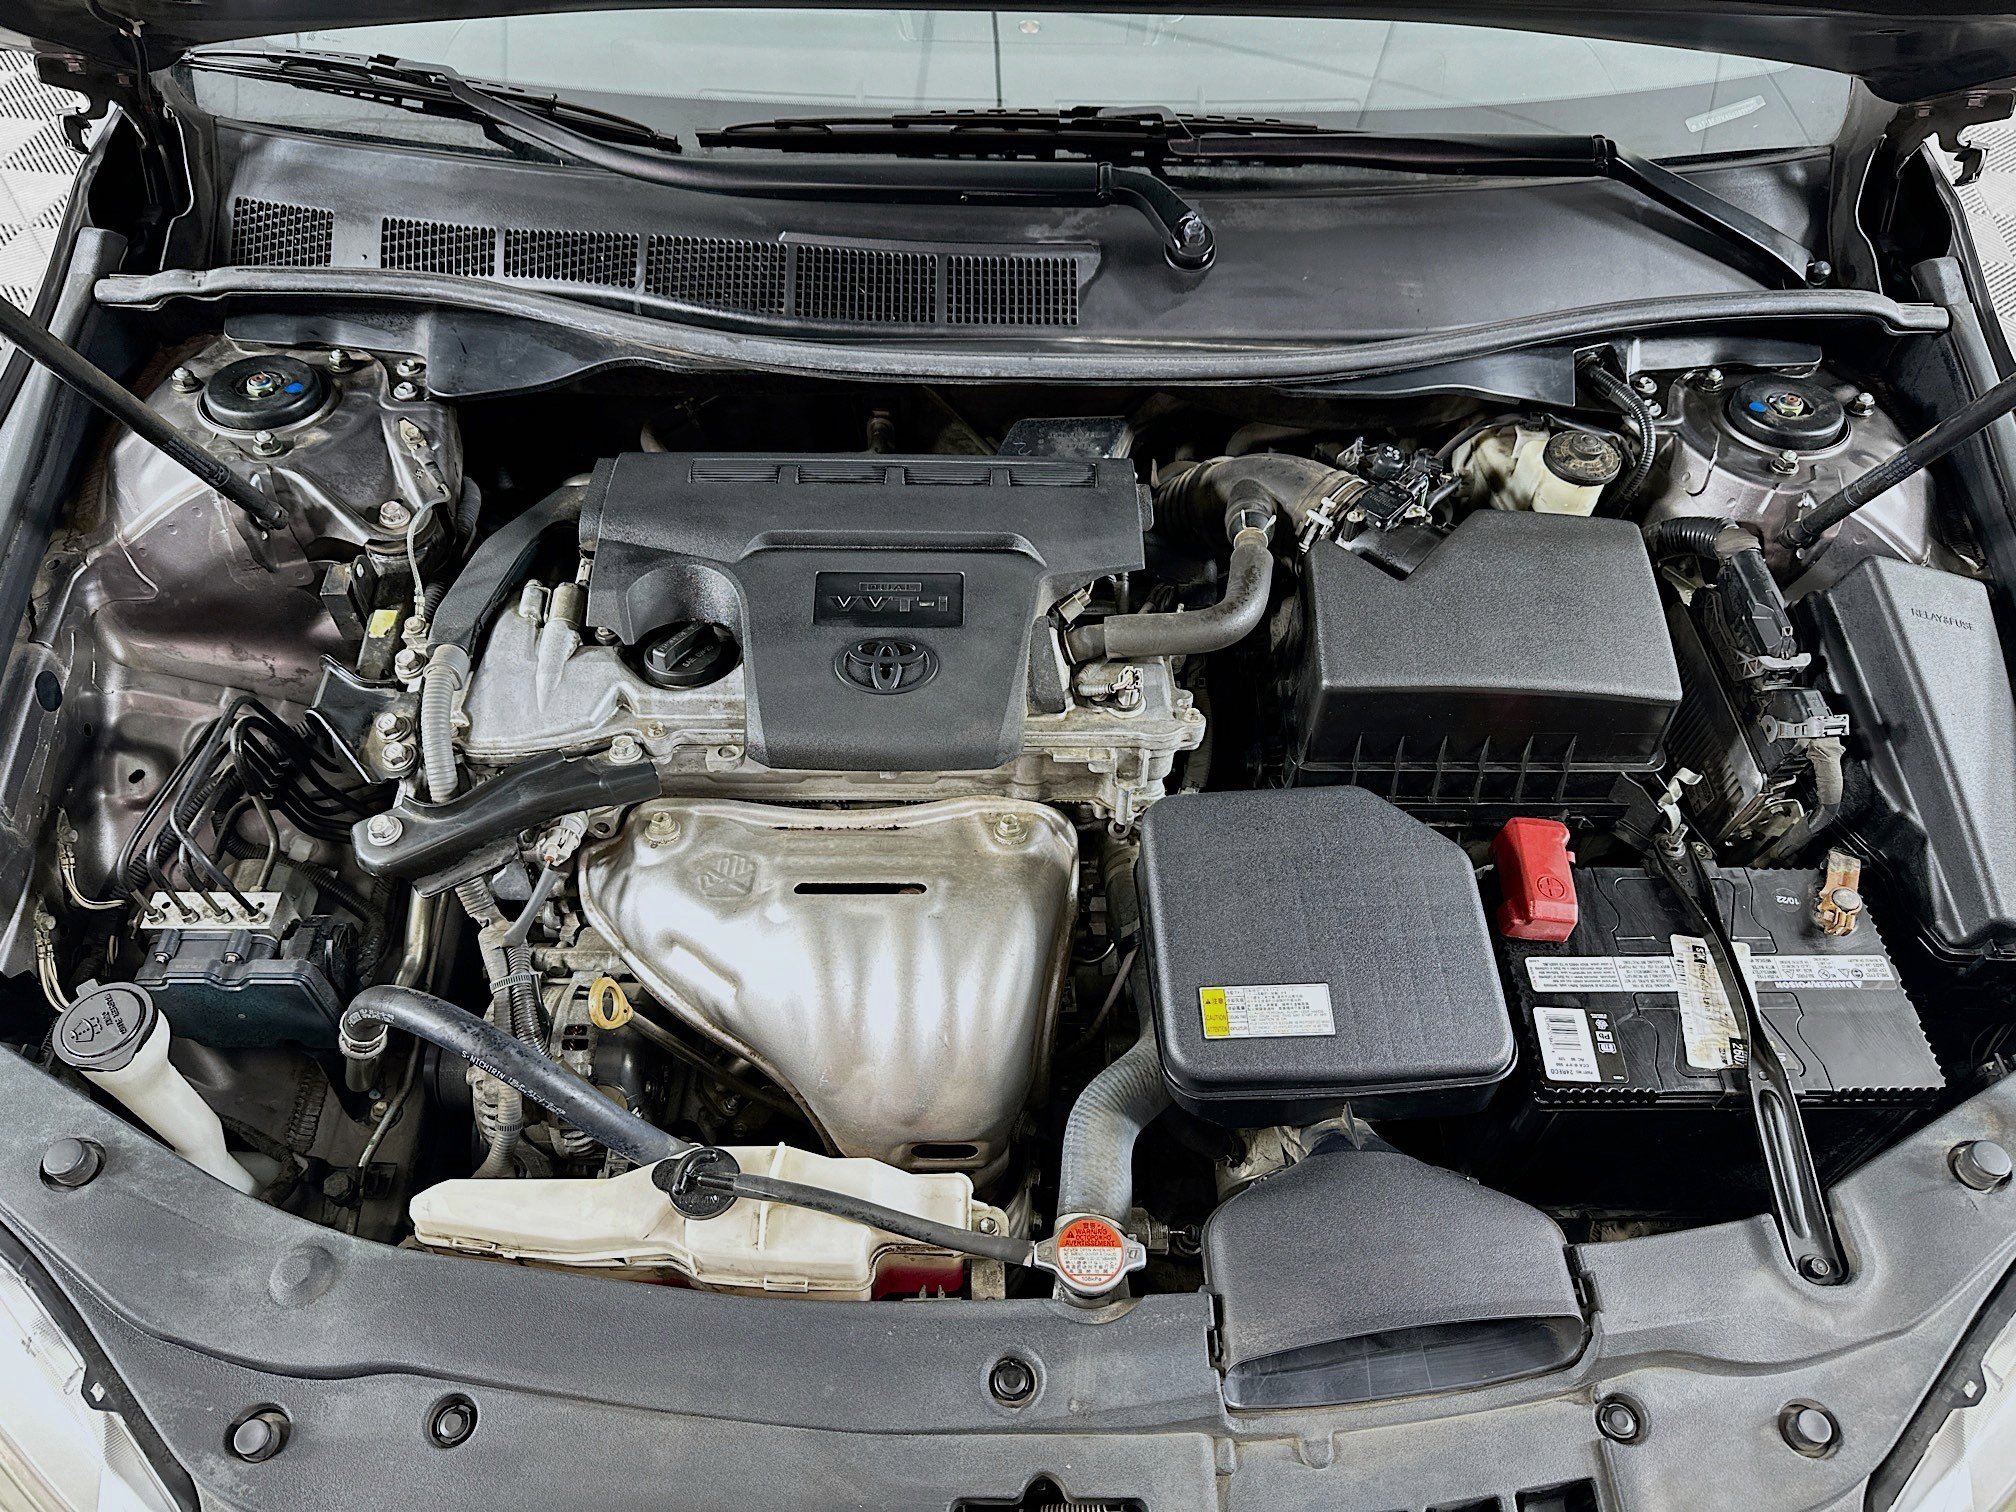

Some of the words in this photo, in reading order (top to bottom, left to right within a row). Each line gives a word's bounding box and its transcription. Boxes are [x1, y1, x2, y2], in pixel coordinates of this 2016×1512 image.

[865, 582, 918, 592] DUAL
[1910, 607, 1974, 631] RELAY&FUSE
[682, 656, 697, 668] SAE
[1775, 895, 1800, 905] 10/22
[1774, 981, 1855, 989] DANGER/POISON
[1205, 1013, 1227, 1021] CAUTION
